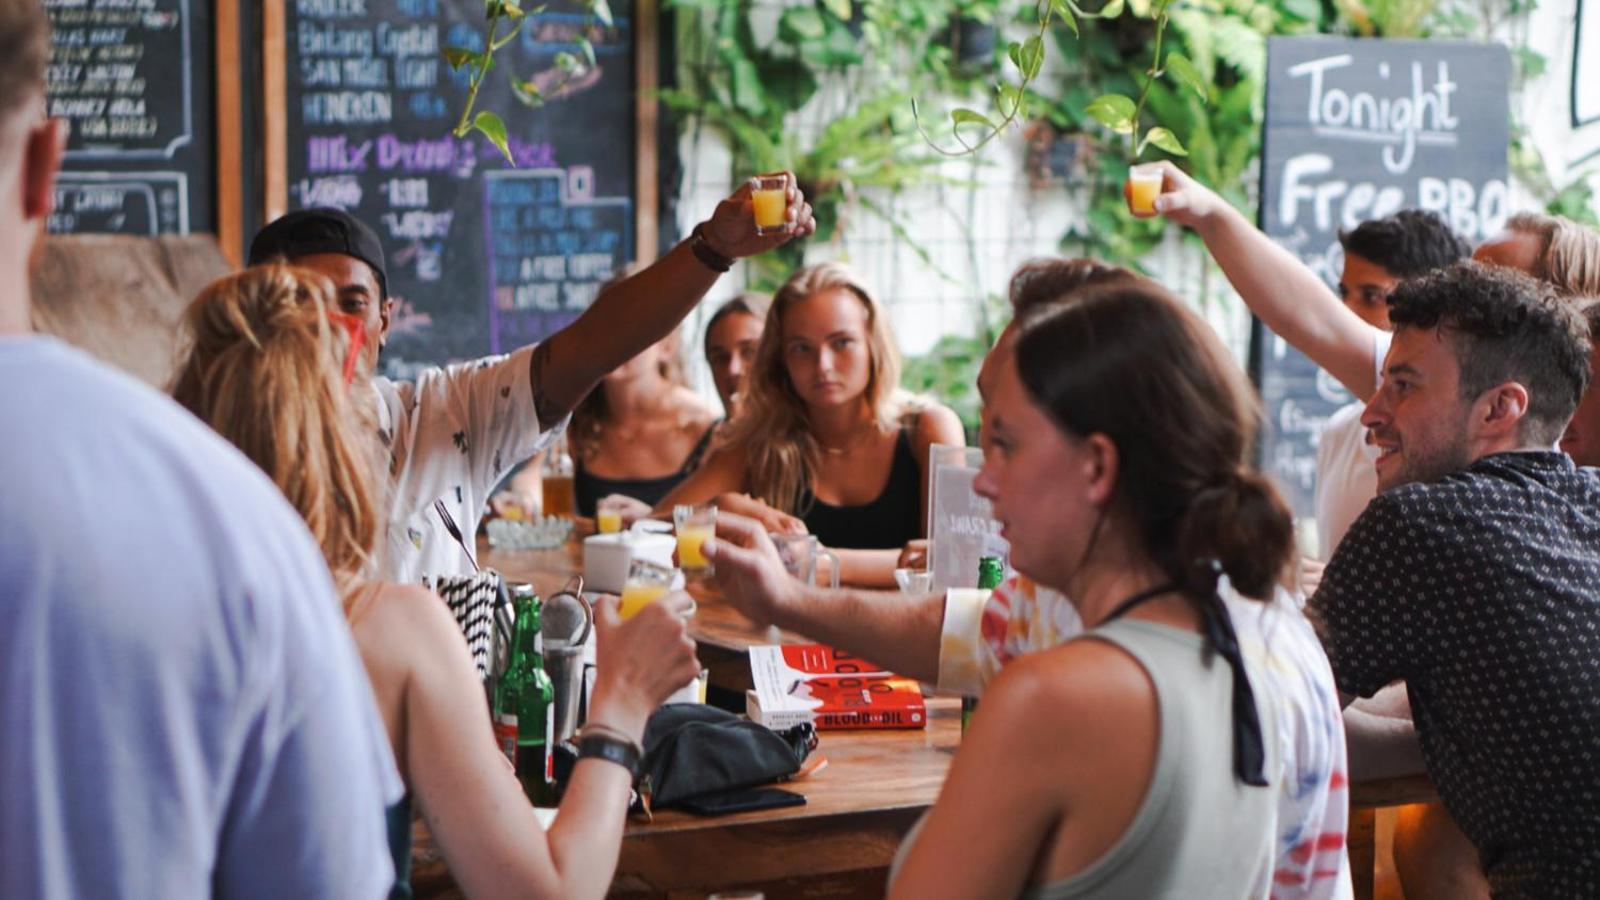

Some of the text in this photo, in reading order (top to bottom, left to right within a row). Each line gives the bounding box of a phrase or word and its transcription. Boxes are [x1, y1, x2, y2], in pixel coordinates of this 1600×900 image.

[1288, 54, 1461, 174] Tonight
[1278, 153, 1403, 234] Free
[824, 710, 870, 725] BLOOD
[882, 710, 904, 724] OIL
